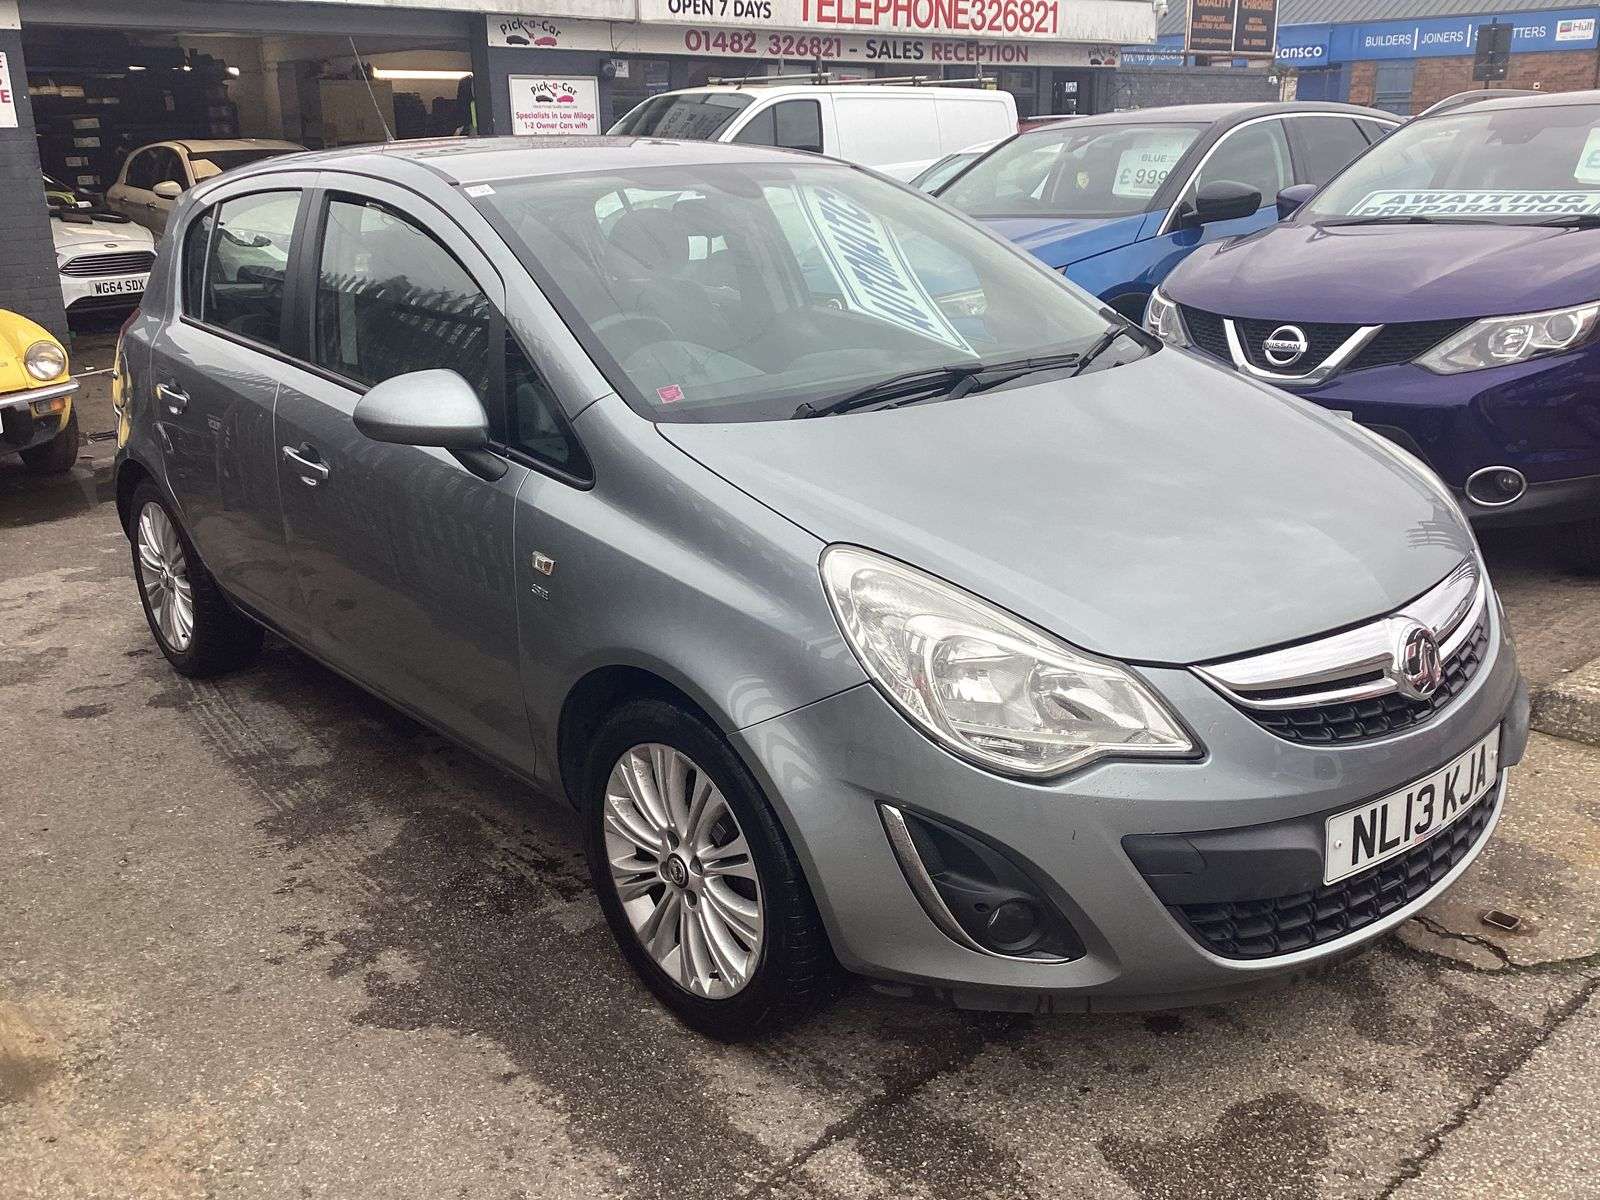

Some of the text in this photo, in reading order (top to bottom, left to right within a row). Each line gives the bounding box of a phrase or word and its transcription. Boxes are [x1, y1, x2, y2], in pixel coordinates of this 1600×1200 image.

[668, 0, 772, 19] OPEN 7 DAYS
[500, 17, 562, 37] Pick-a-Car
[684, 29, 757, 53] 01482
[768, 33, 842, 57] 326821
[865, 39, 924, 60] SALES
[931, 42, 1029, 62] RECEPTION
[1365, 33, 1412, 47] BUILDERS
[1421, 31, 1464, 44] JOINERS
[530, 81, 578, 96] Pick-a-Car
[516, 111, 549, 121] Specialists
[559, 121, 573, 129] Cars
[574, 121, 588, 129] with
[1381, 194, 1589, 204] AWAITING
[1361, 204, 1592, 216] PREPARATION
[814, 186, 946, 338] AUTOMATIC
[95, 279, 145, 294] WG64 SDX
[1264, 342, 1302, 350] NISSAN
[1351, 743, 1486, 866] NL13 KJA
